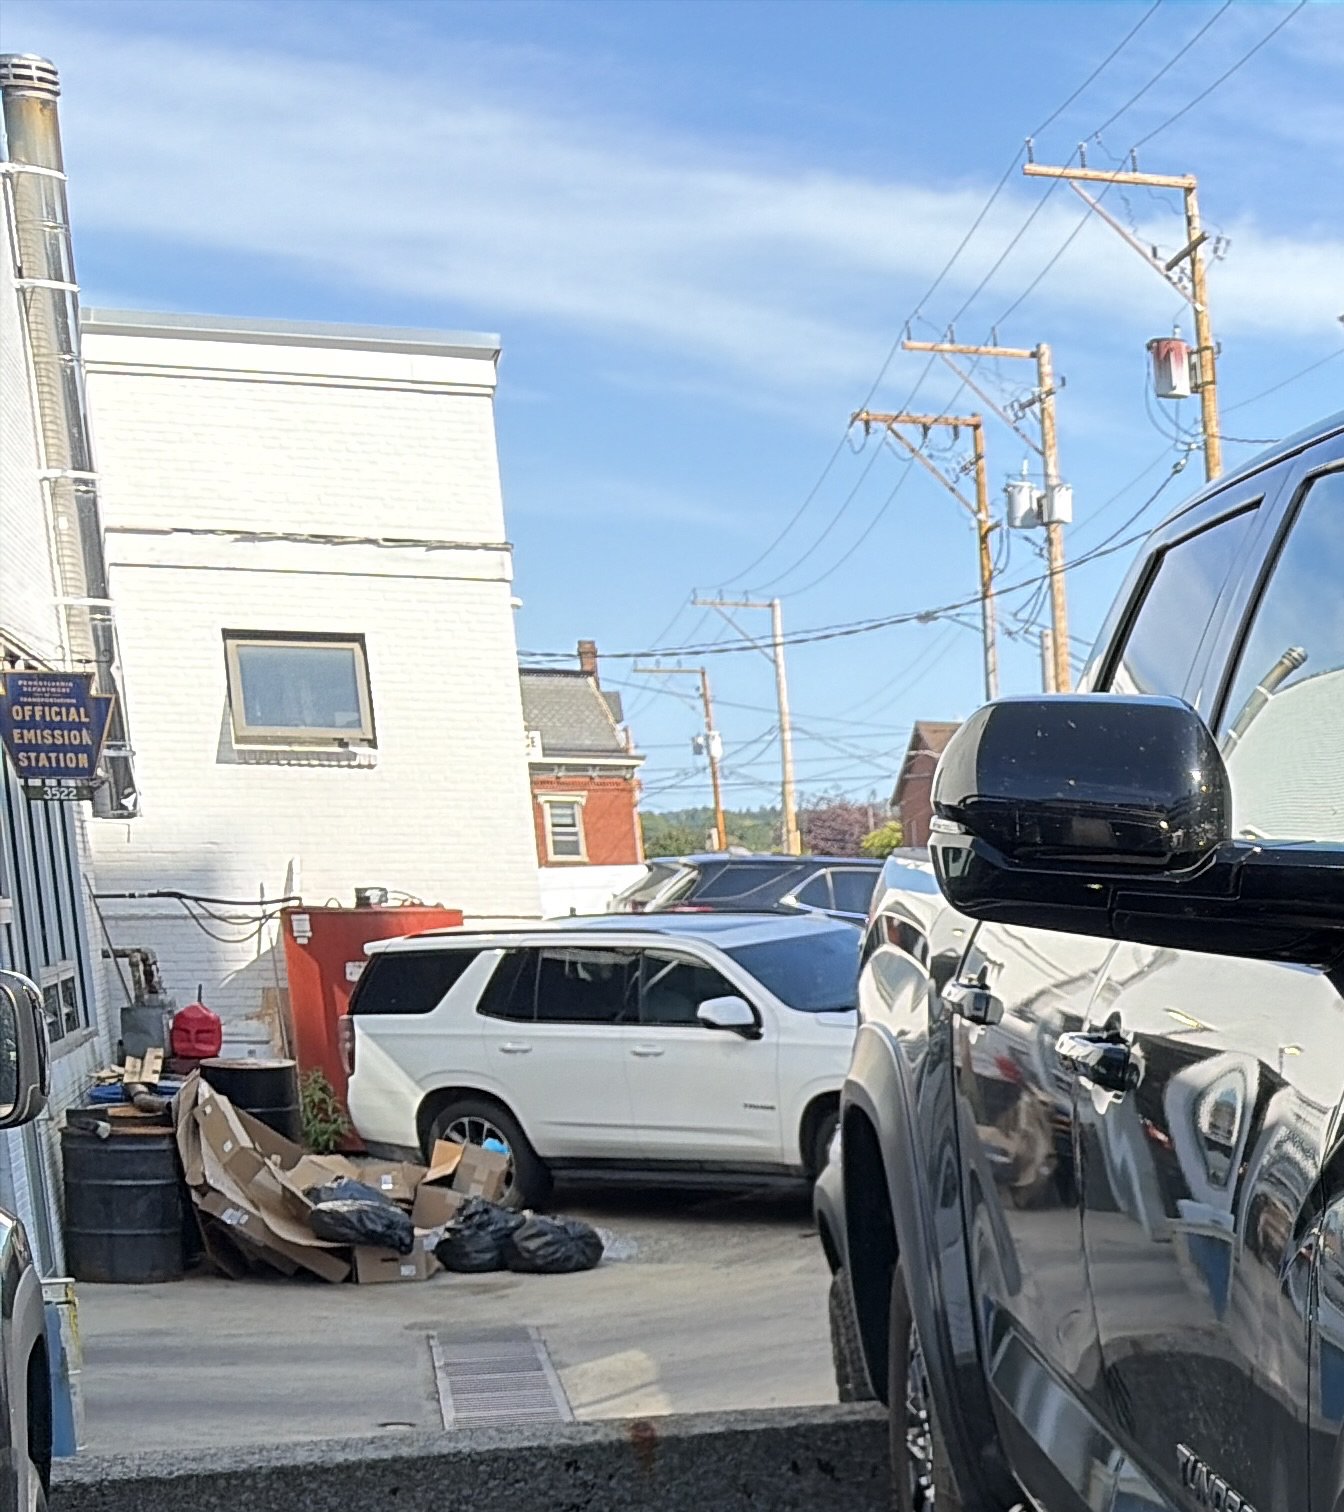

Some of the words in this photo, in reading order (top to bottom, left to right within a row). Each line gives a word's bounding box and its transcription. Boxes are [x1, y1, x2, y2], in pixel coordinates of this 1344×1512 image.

[12, 705, 90, 722] OFFICIAL
[13, 728, 92, 745] EMISSION
[18, 752, 89, 768] STATION
[43, 788, 78, 800] 3522
